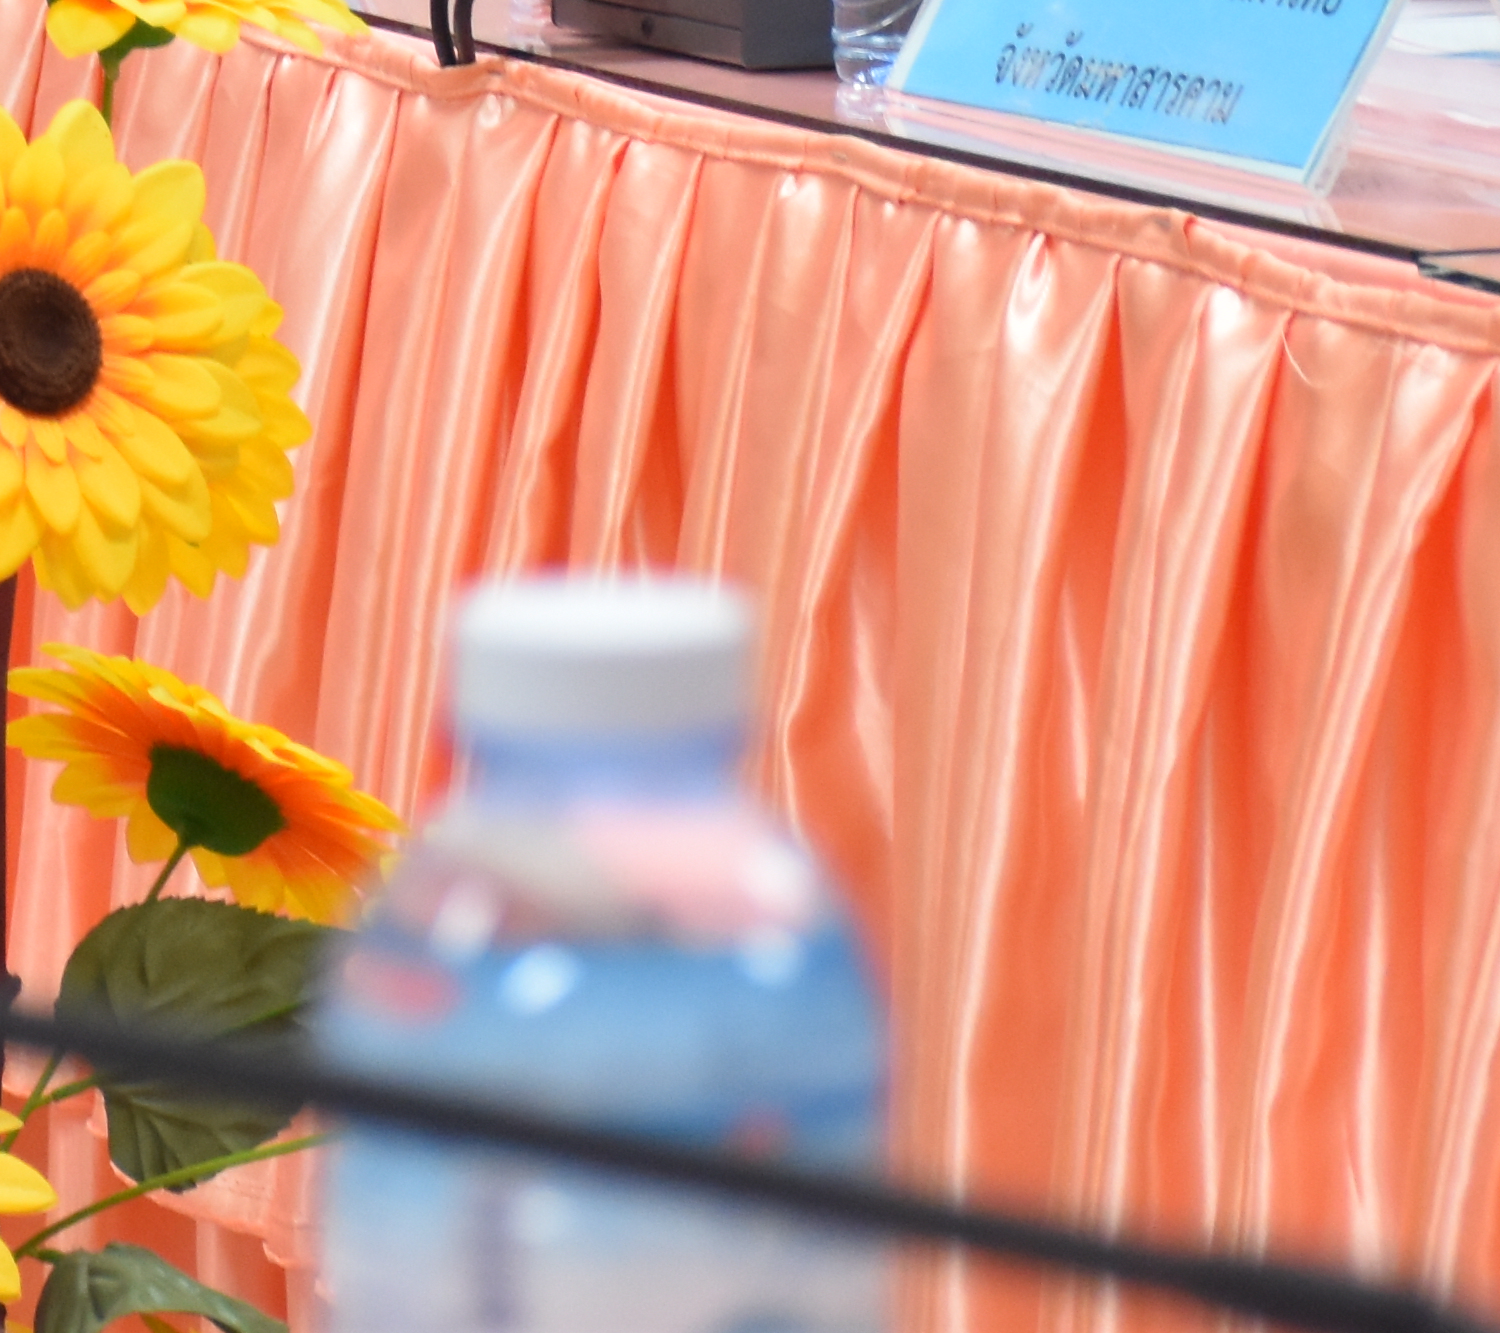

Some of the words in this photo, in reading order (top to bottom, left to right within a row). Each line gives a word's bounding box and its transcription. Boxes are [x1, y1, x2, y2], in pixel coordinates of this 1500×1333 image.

[994, 21, 1245, 125] จังหวัดมหาสารคาม
